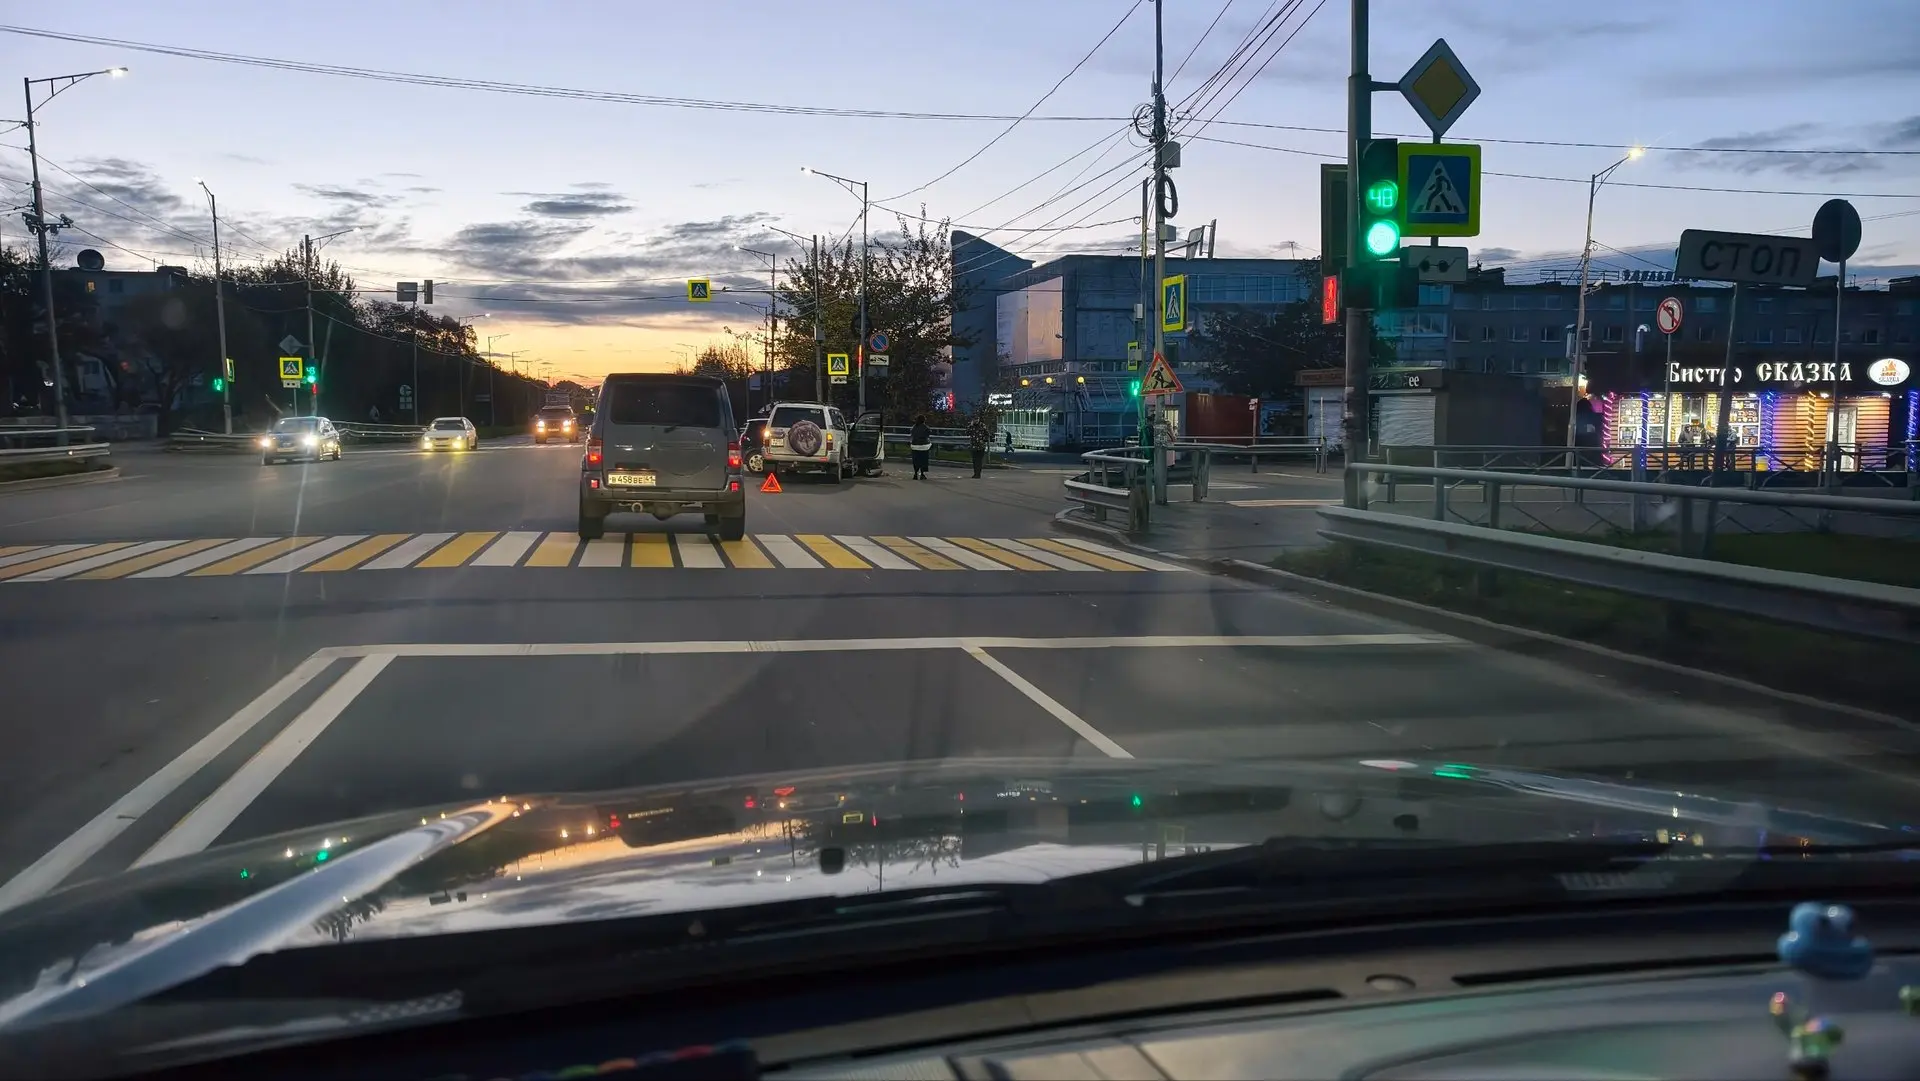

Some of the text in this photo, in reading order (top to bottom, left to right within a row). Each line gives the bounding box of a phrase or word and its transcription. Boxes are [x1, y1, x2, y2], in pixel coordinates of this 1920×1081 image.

[1369, 188, 1393, 208] 48
[1700, 240, 1800, 276] СТОП
[1756, 362, 1853, 383] СКАЗКА
